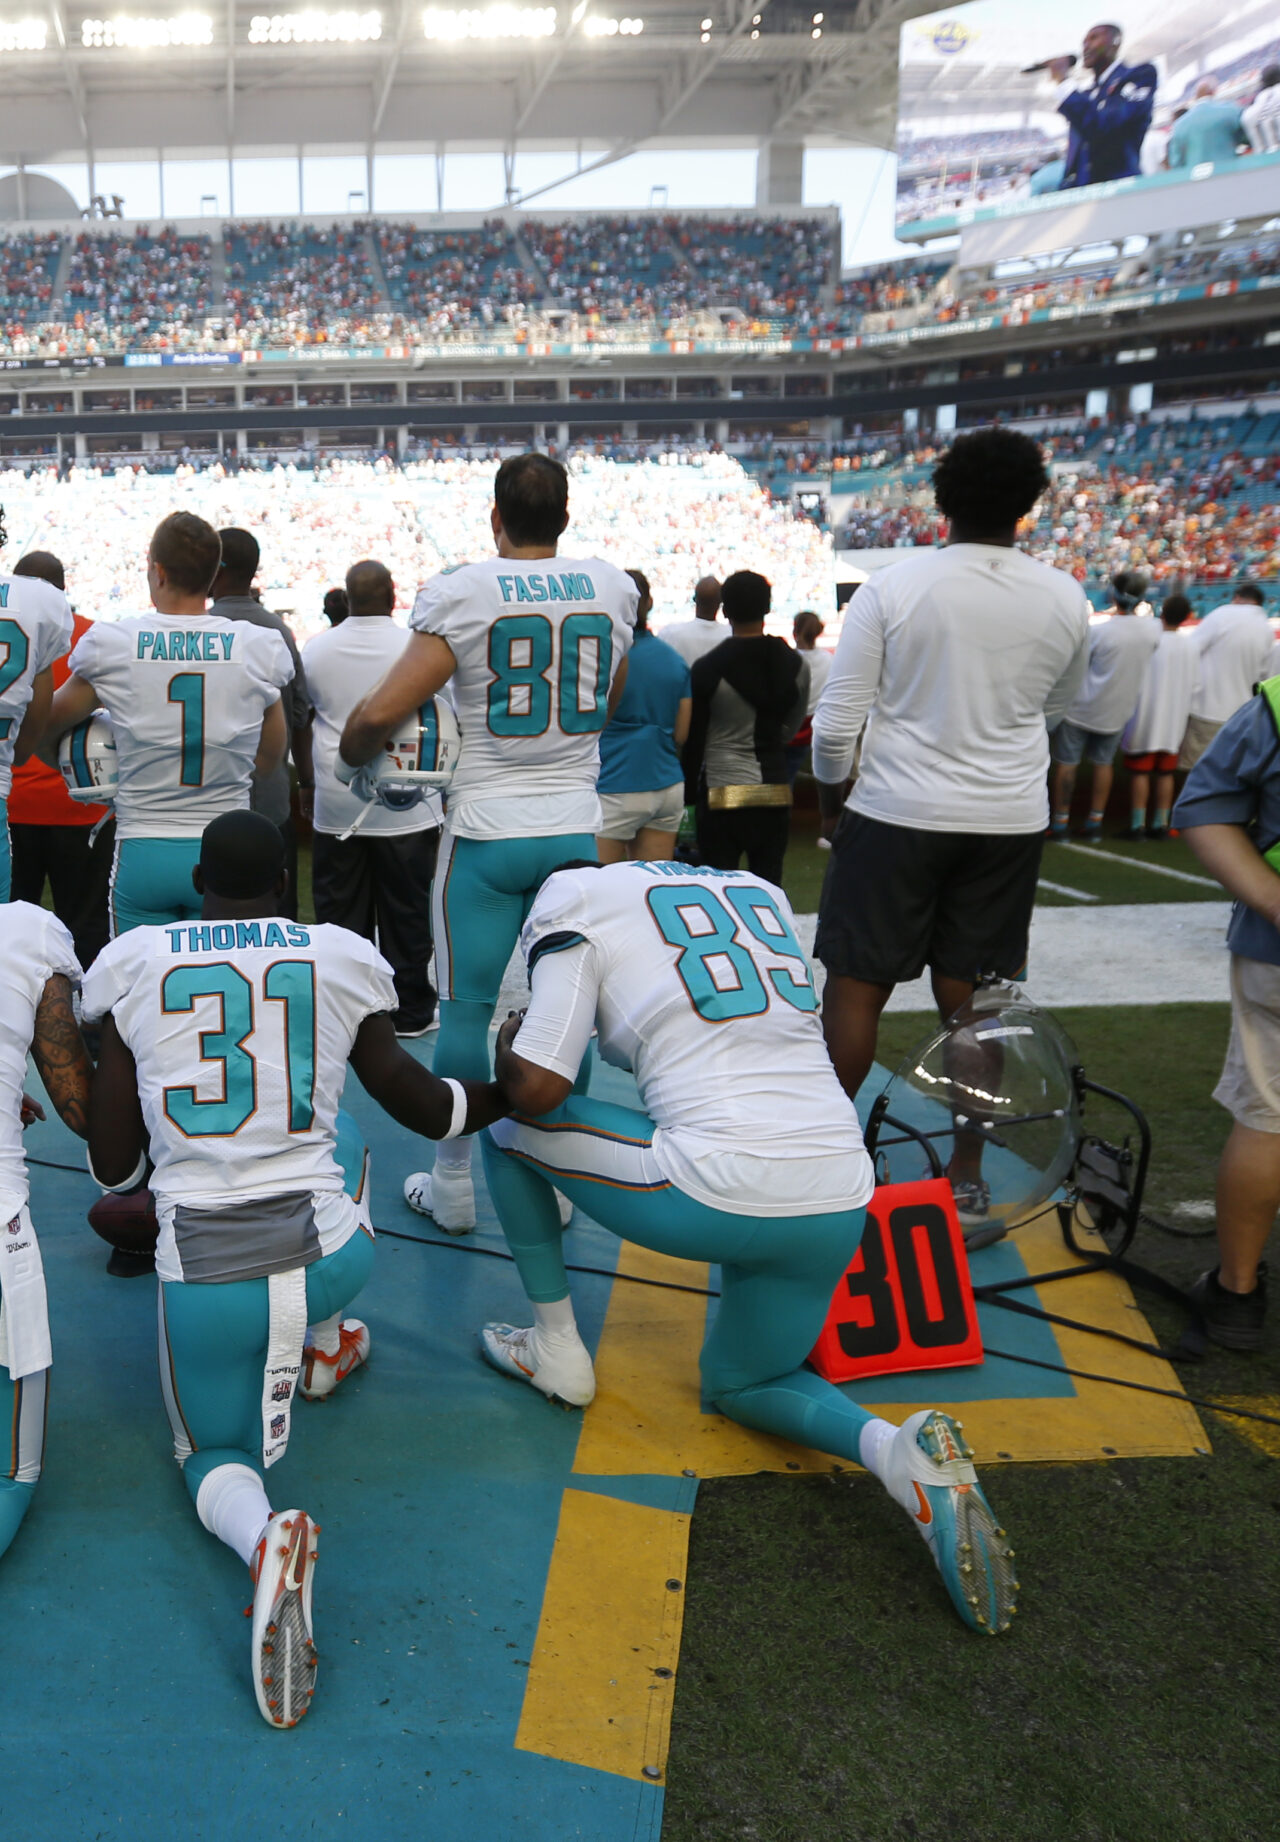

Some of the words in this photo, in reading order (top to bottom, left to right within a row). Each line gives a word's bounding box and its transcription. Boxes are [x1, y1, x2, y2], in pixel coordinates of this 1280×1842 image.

[497, 573, 595, 602] FASANO
[137, 631, 235, 661] PARKEY
[486, 612, 613, 738] 80
[167, 672, 205, 787] 1
[165, 922, 311, 952] THOMAS
[645, 883, 821, 1024] 89
[160, 959, 317, 1139] 31
[5, 1242, 31, 1253] Wilson
[837, 1204, 970, 1359] 30
[271, 1423, 284, 1437] NFL
